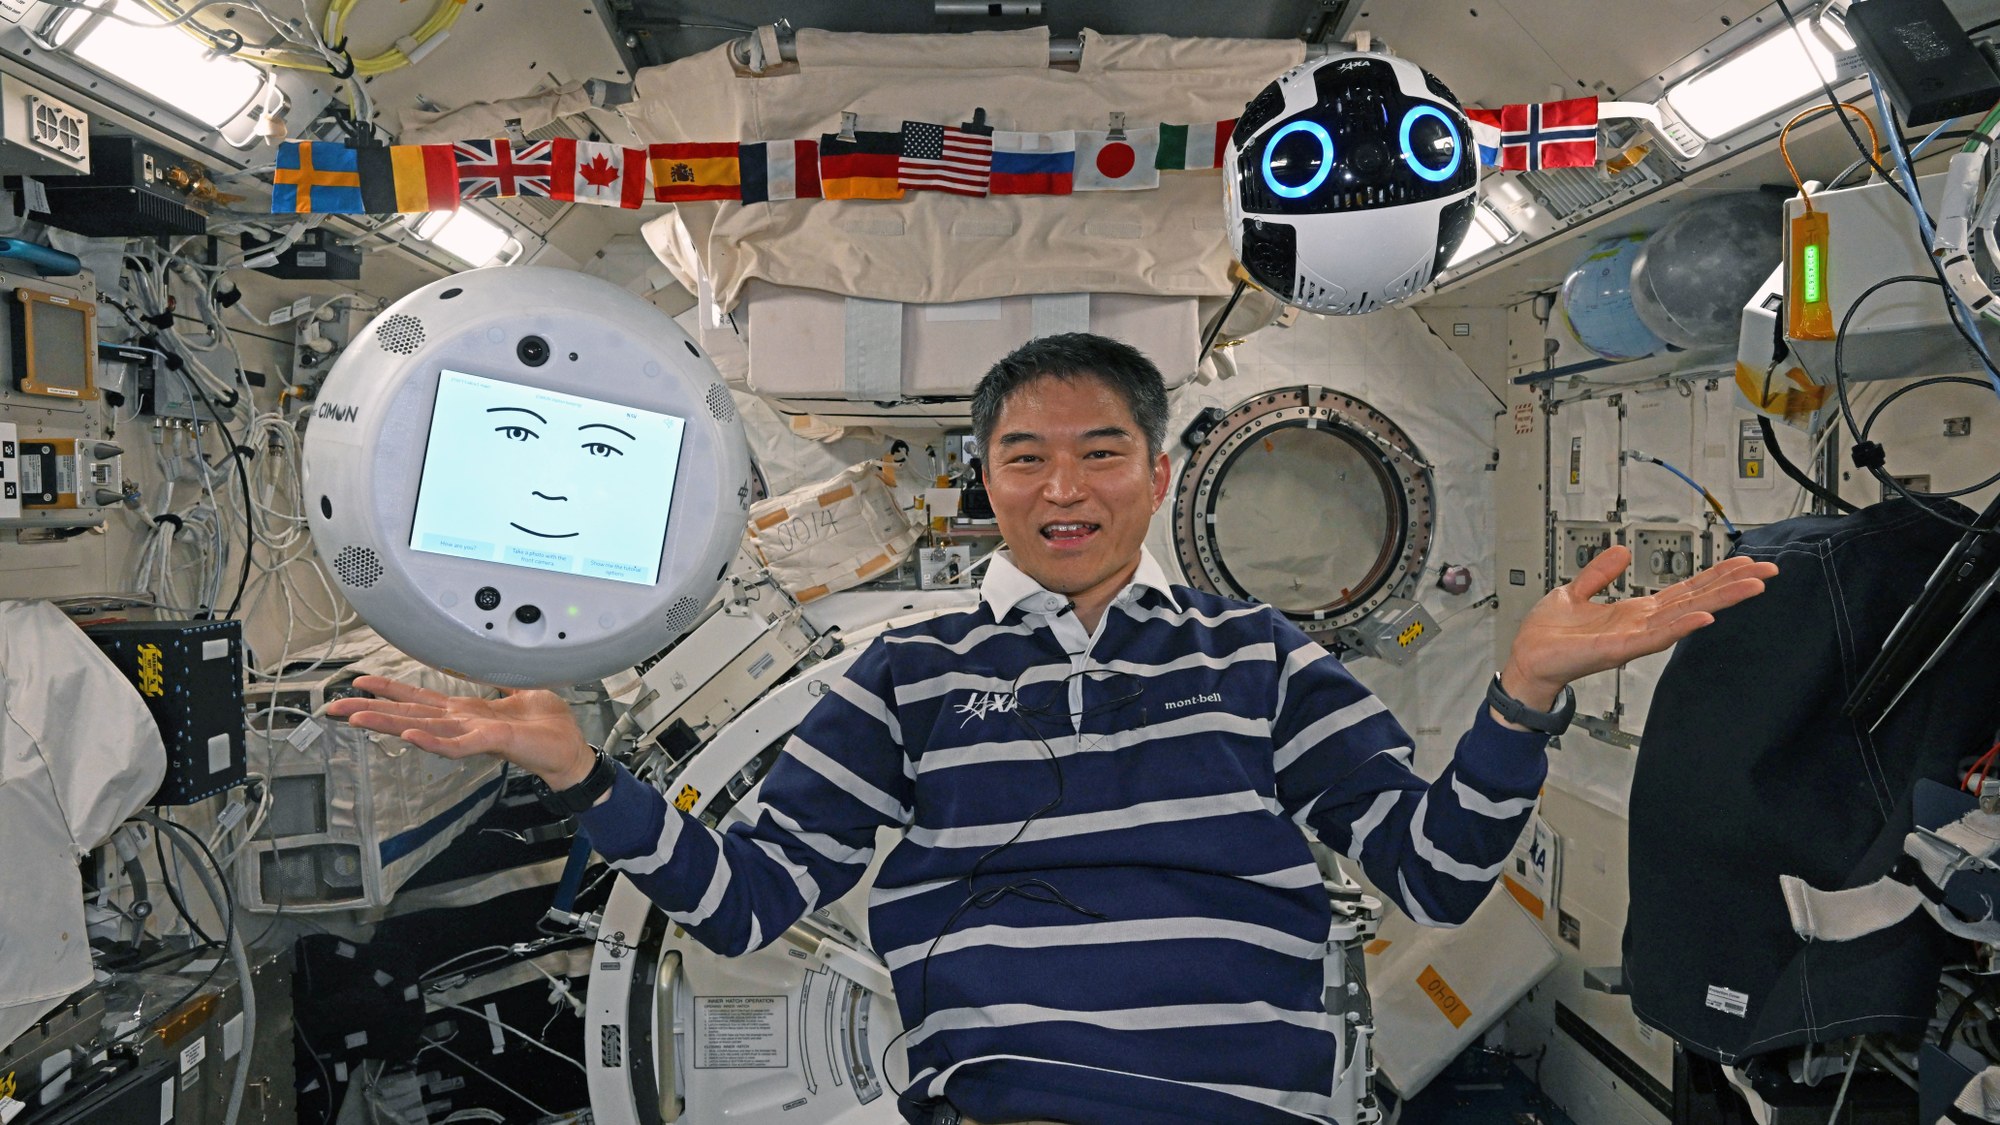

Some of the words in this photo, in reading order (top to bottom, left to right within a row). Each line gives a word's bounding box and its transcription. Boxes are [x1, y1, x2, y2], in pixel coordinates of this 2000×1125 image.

[1337, 60, 1371, 74] JAXA
[777, 509, 839, 552] 0014
[1427, 979, 1460, 1014] 1040
